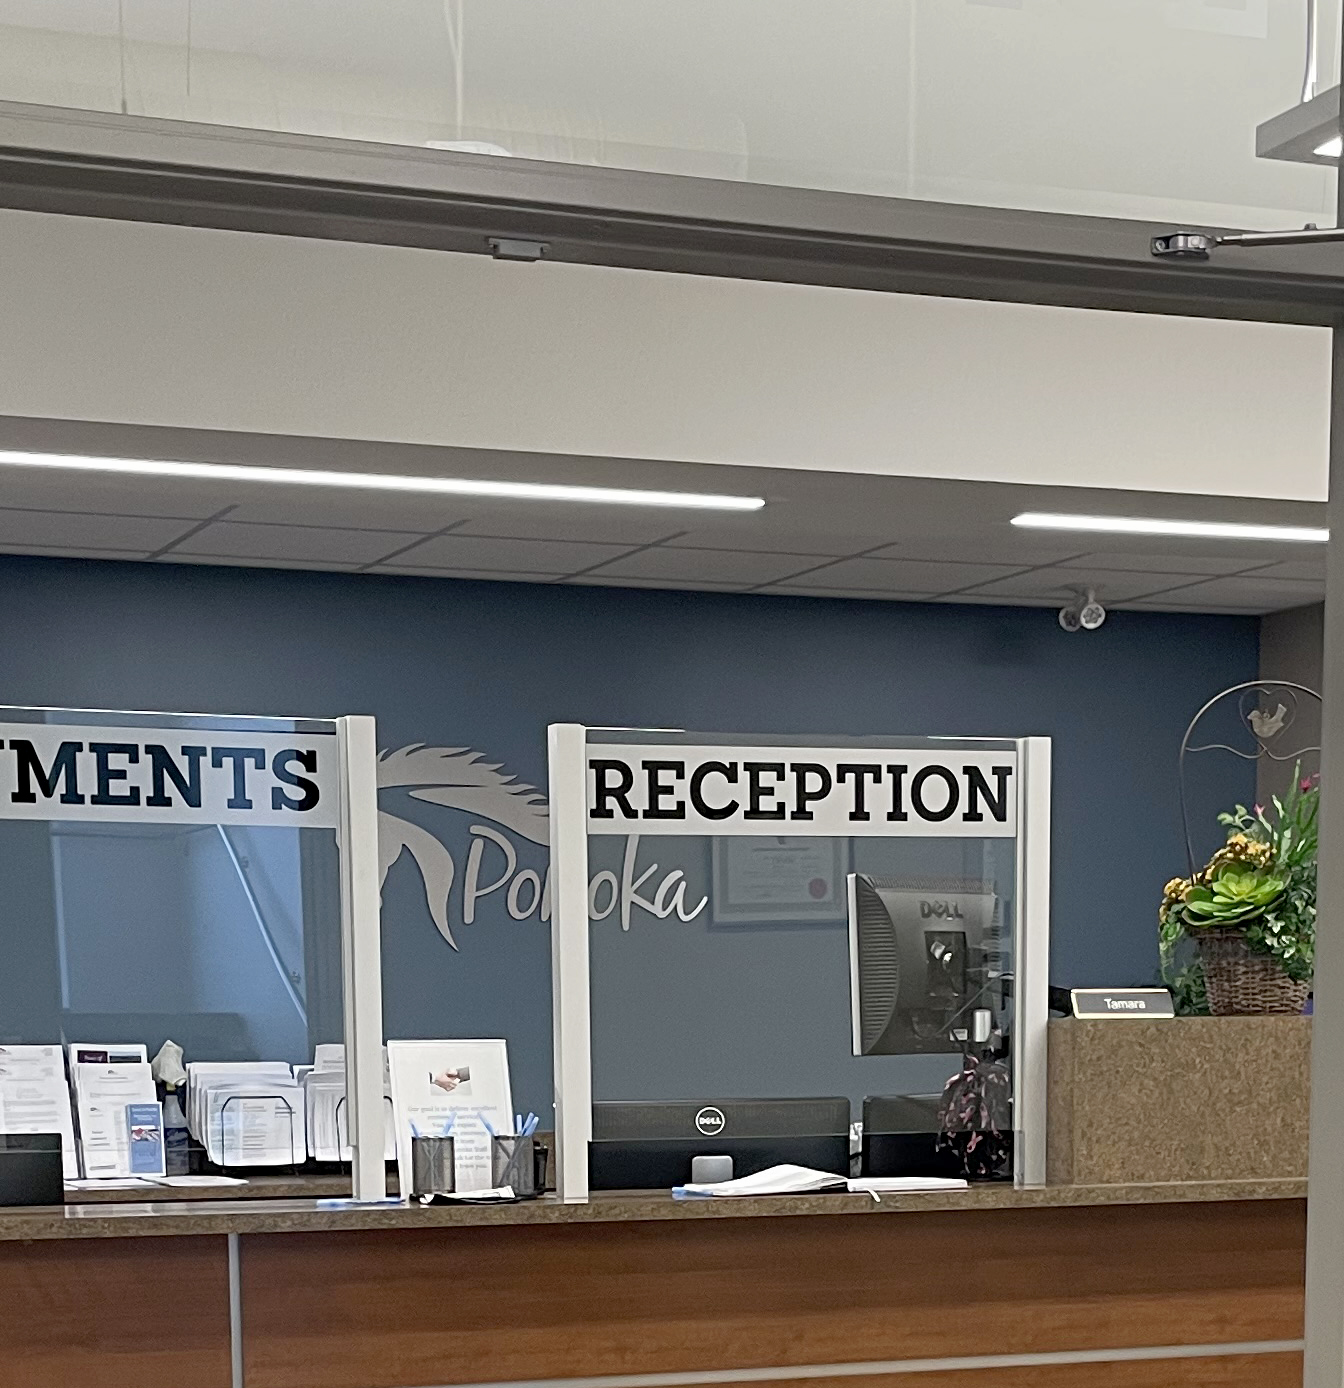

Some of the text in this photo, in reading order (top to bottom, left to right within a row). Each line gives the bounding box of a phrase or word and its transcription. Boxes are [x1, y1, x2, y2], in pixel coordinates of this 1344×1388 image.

[588, 758, 1013, 823] RECEPTION
[463, 825, 708, 932] Pooka
[919, 900, 964, 919] DELL
[1103, 997, 1146, 1010] Tamara
[699, 1116, 722, 1125] DELL
